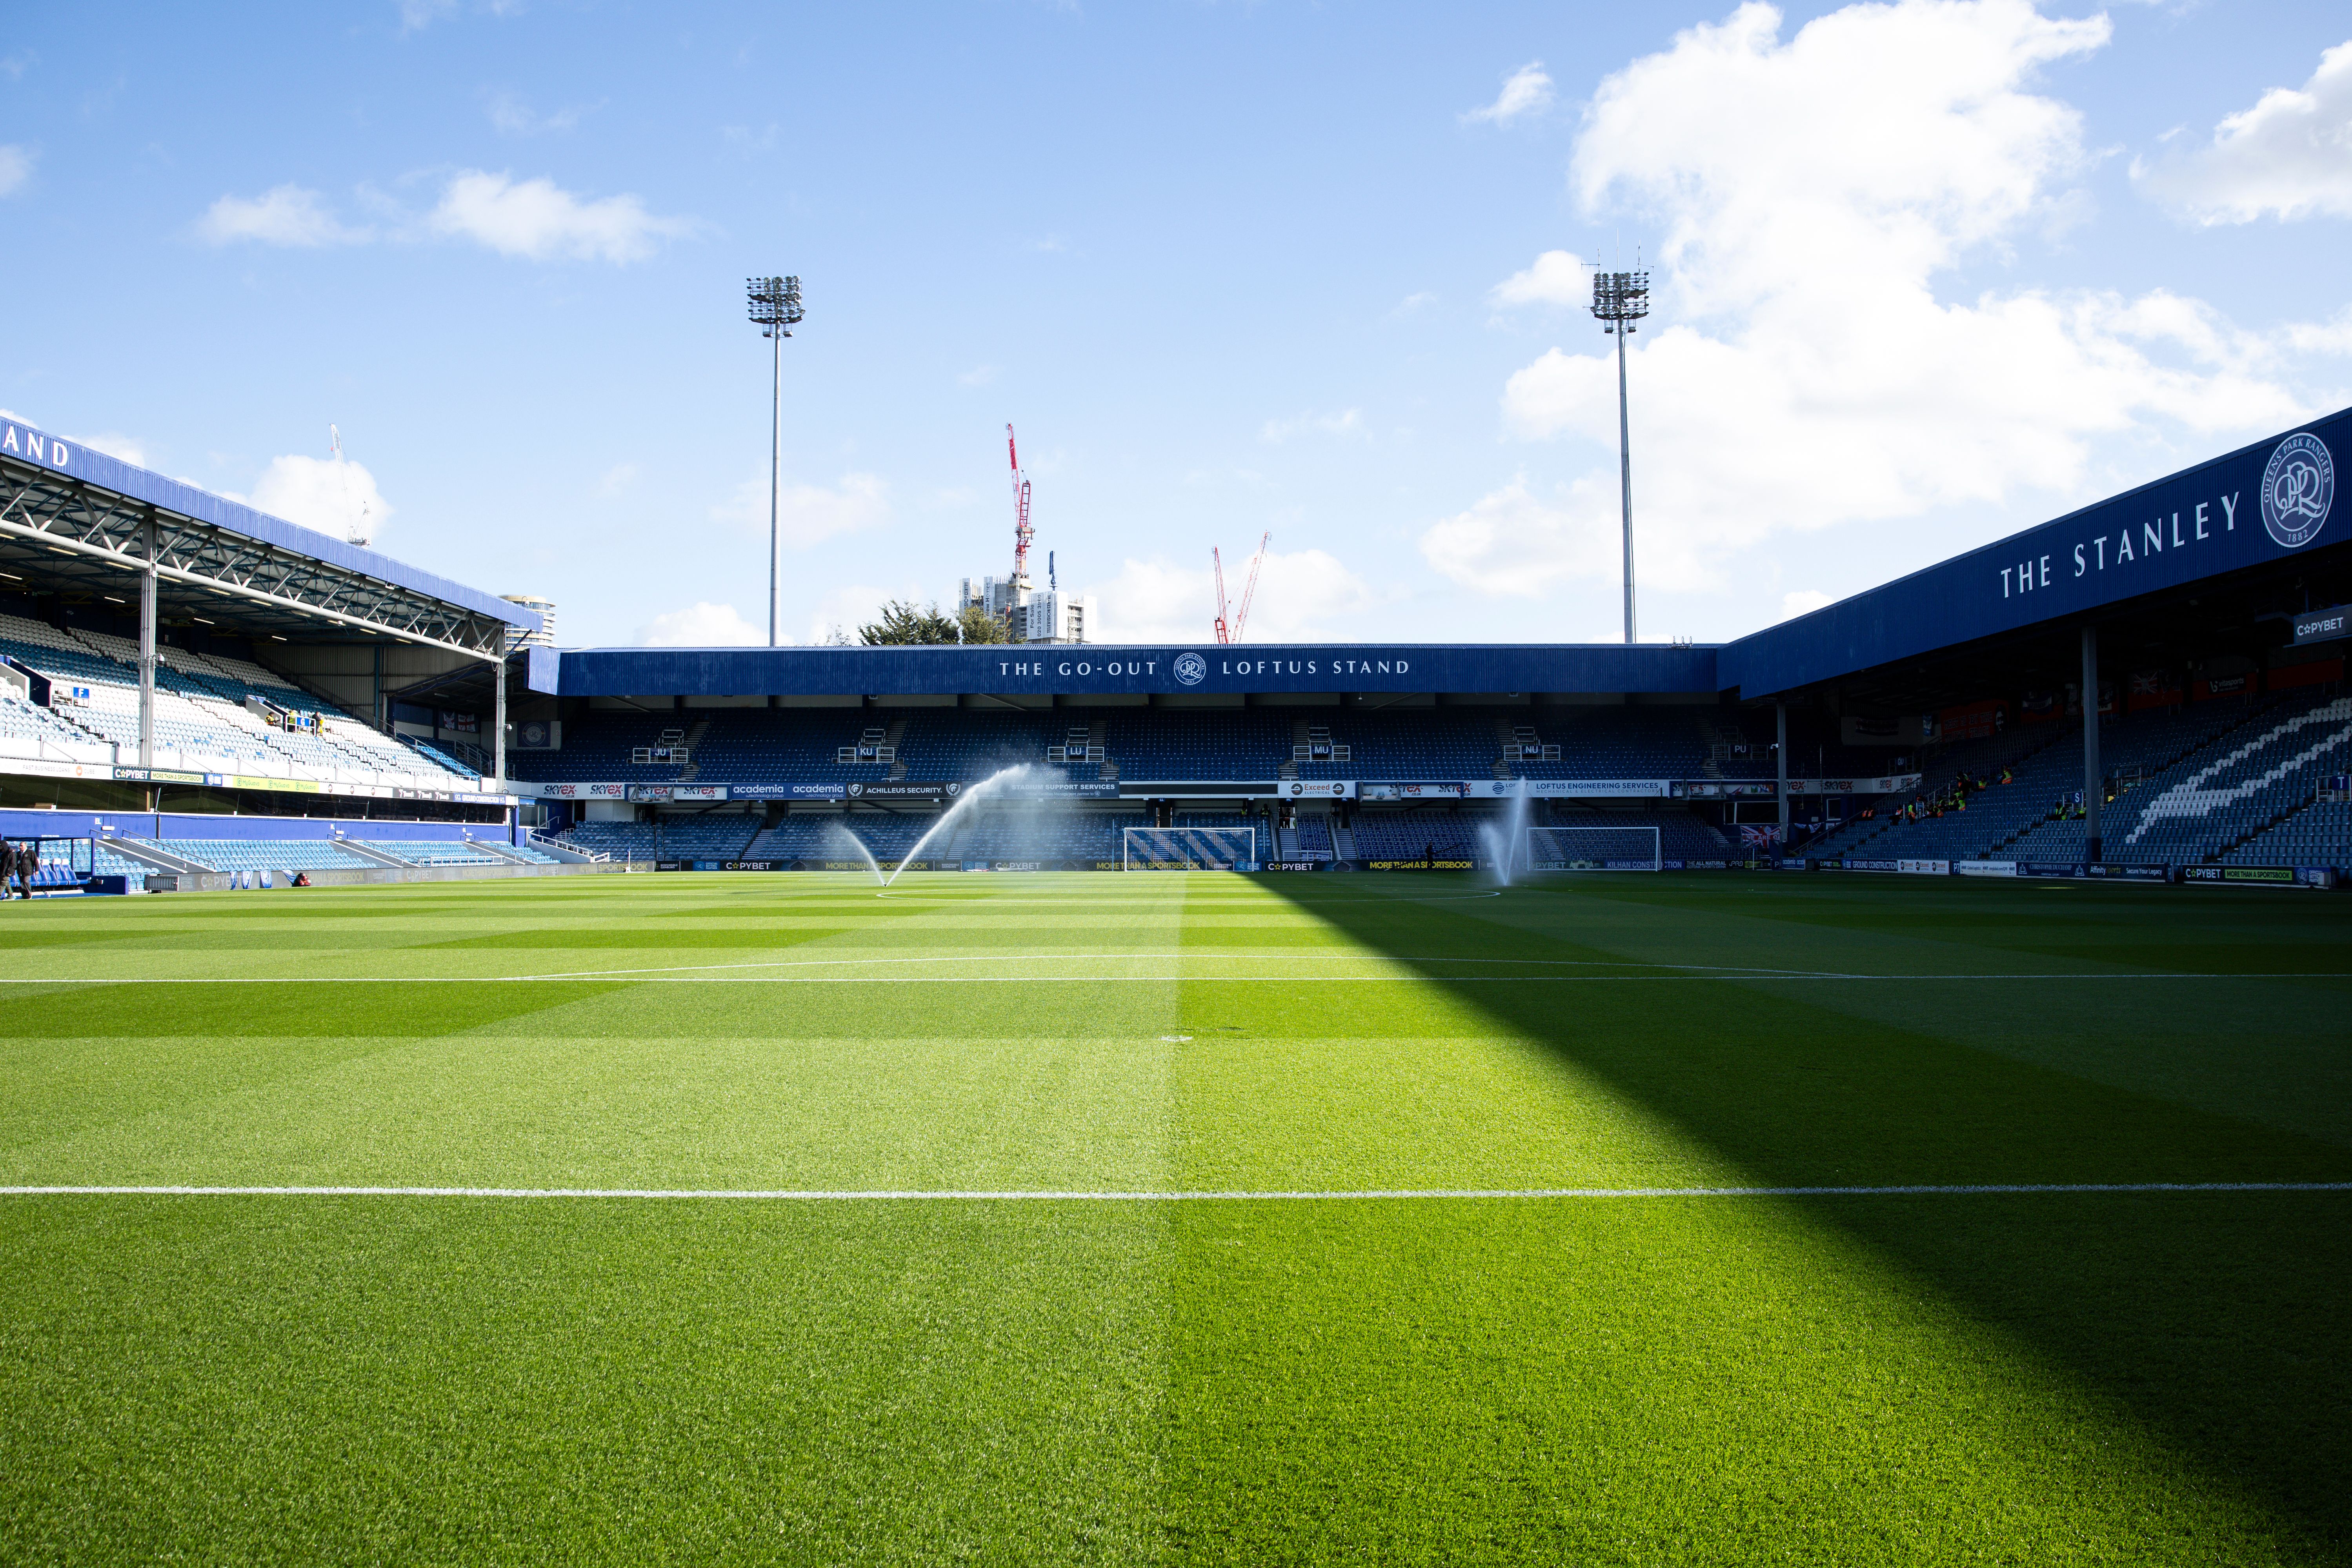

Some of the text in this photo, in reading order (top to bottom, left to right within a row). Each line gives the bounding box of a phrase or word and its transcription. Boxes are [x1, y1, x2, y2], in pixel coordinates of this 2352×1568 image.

[2264, 438, 2330, 503] QUEENS PARK RANGERS
[2288, 529, 2308, 542] 1882
[2001, 491, 2239, 598] THE STANLEY
[1175, 657, 1184, 670] QUEENS
[1194, 655, 1204, 670] RANGERS
[1223, 660, 1409, 674] LOFTUS STAND
[1000, 662, 1156, 675] THE GO-OUT
[2219, 677, 2244, 687] vitasports
[78, 688, 84, 697] F
[2337, 777, 2345, 788] T
[733, 784, 784, 793] academia
[793, 784, 843, 793] academia
[2075, 793, 2079, 802] S
[1869, 861, 1897, 869] CONSTRUCTION
[1954, 863, 1960, 873] P7
[2090, 865, 2106, 875] Affinity
[2148, 868, 2162, 877] Legacy
